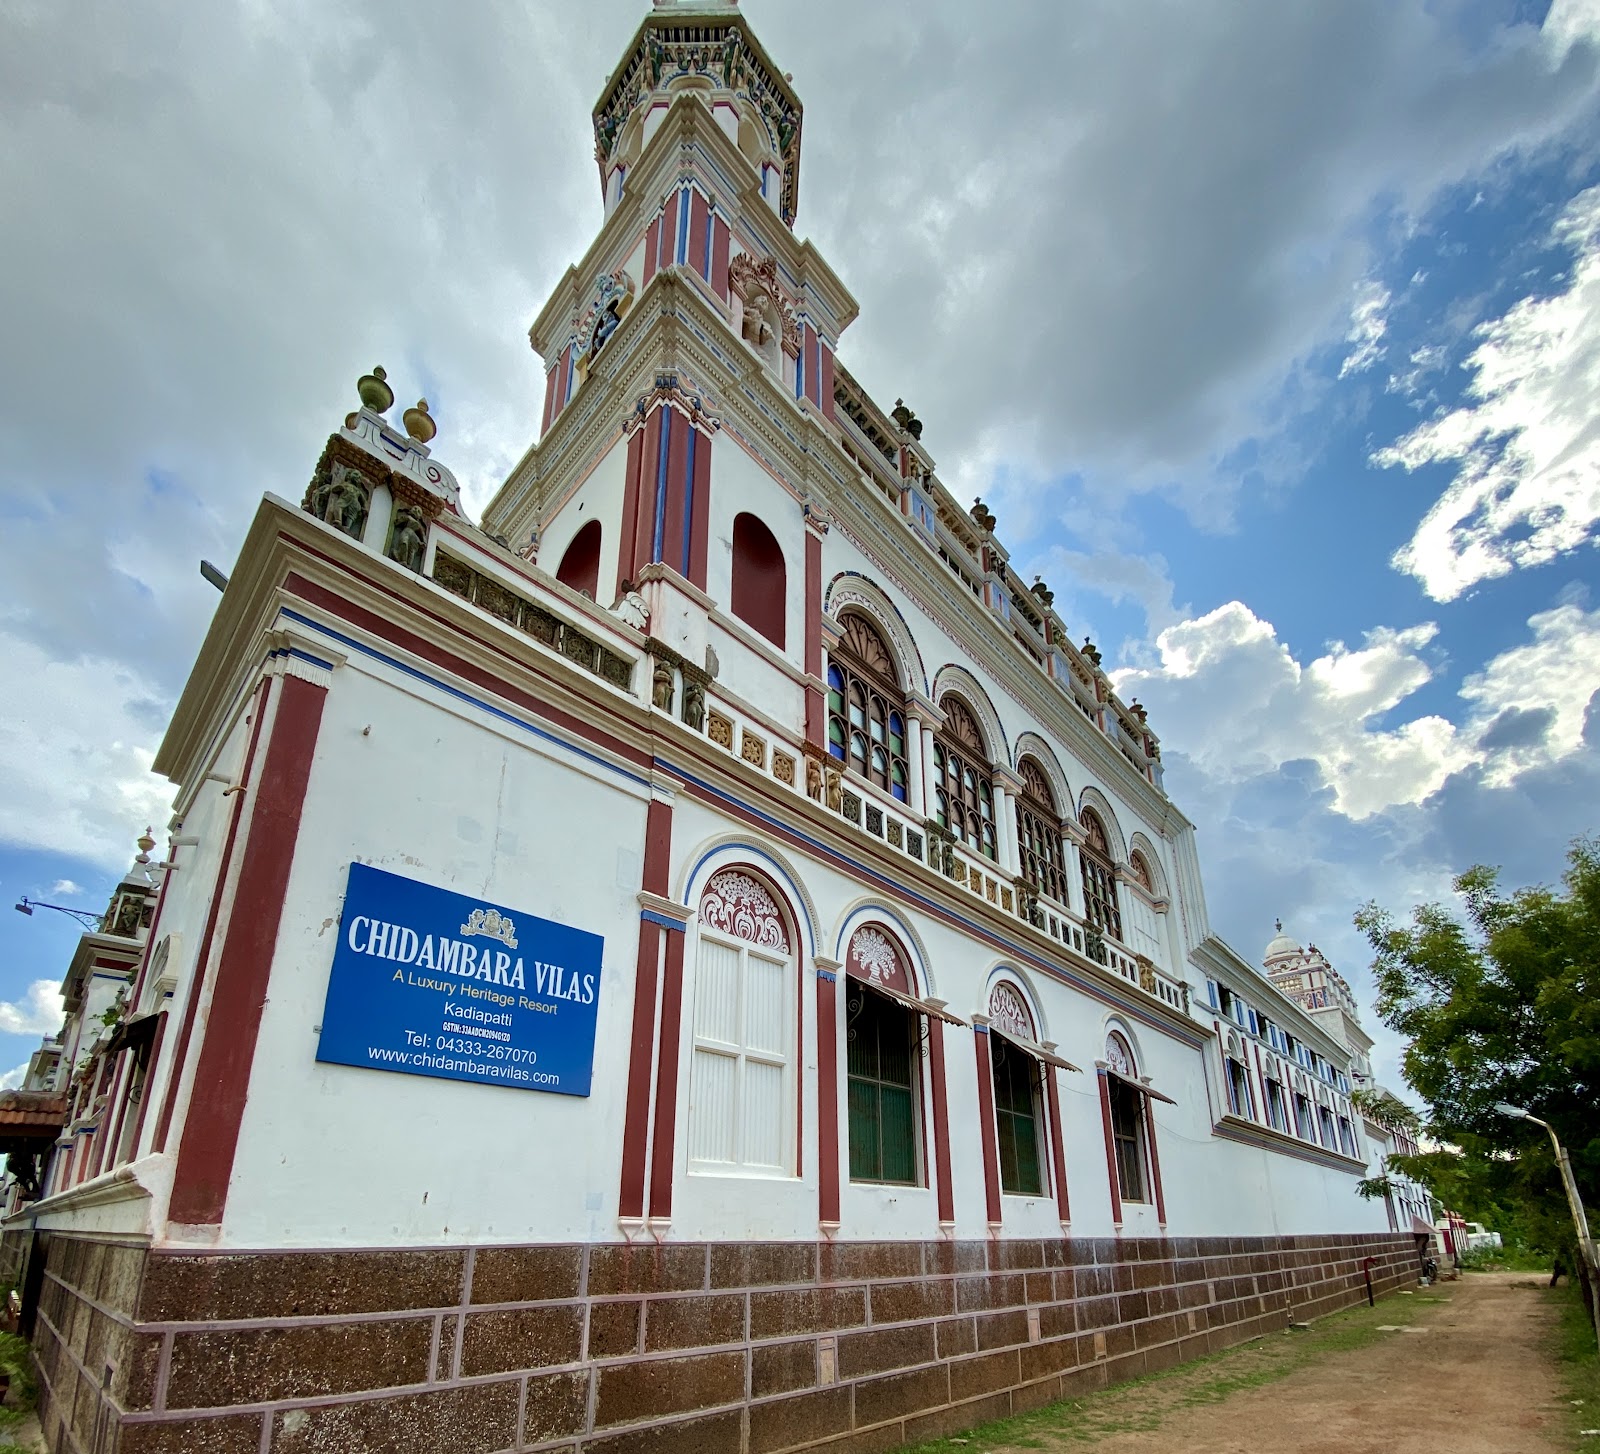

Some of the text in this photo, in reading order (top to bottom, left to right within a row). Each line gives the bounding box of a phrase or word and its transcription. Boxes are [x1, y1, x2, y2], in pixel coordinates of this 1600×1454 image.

[348, 915, 594, 1005] CHIDAMBARA VILAS
[392, 969, 558, 1016] A Luxury Heritage Resort
[444, 1002, 512, 1027] Kadiapatti
[405, 1030, 537, 1065] Tel: 04333-267070
